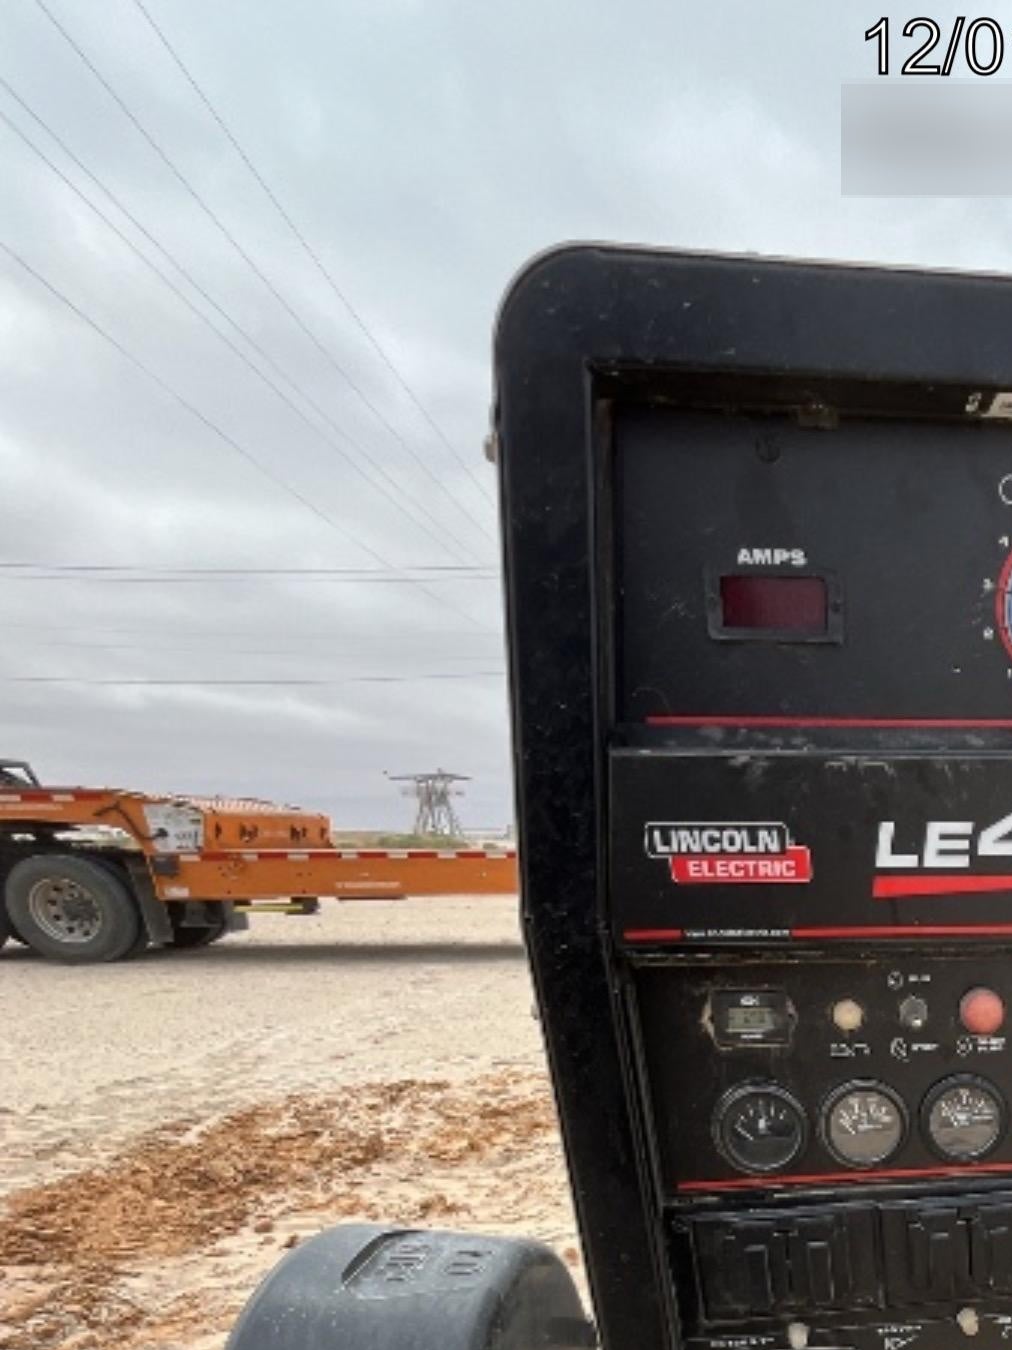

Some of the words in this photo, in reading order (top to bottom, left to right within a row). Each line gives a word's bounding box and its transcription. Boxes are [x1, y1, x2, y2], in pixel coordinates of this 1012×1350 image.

[737, 548, 807, 566] AMPS
[652, 828, 781, 854] LINCOLN
[687, 860, 796, 877] ELECTRIC
